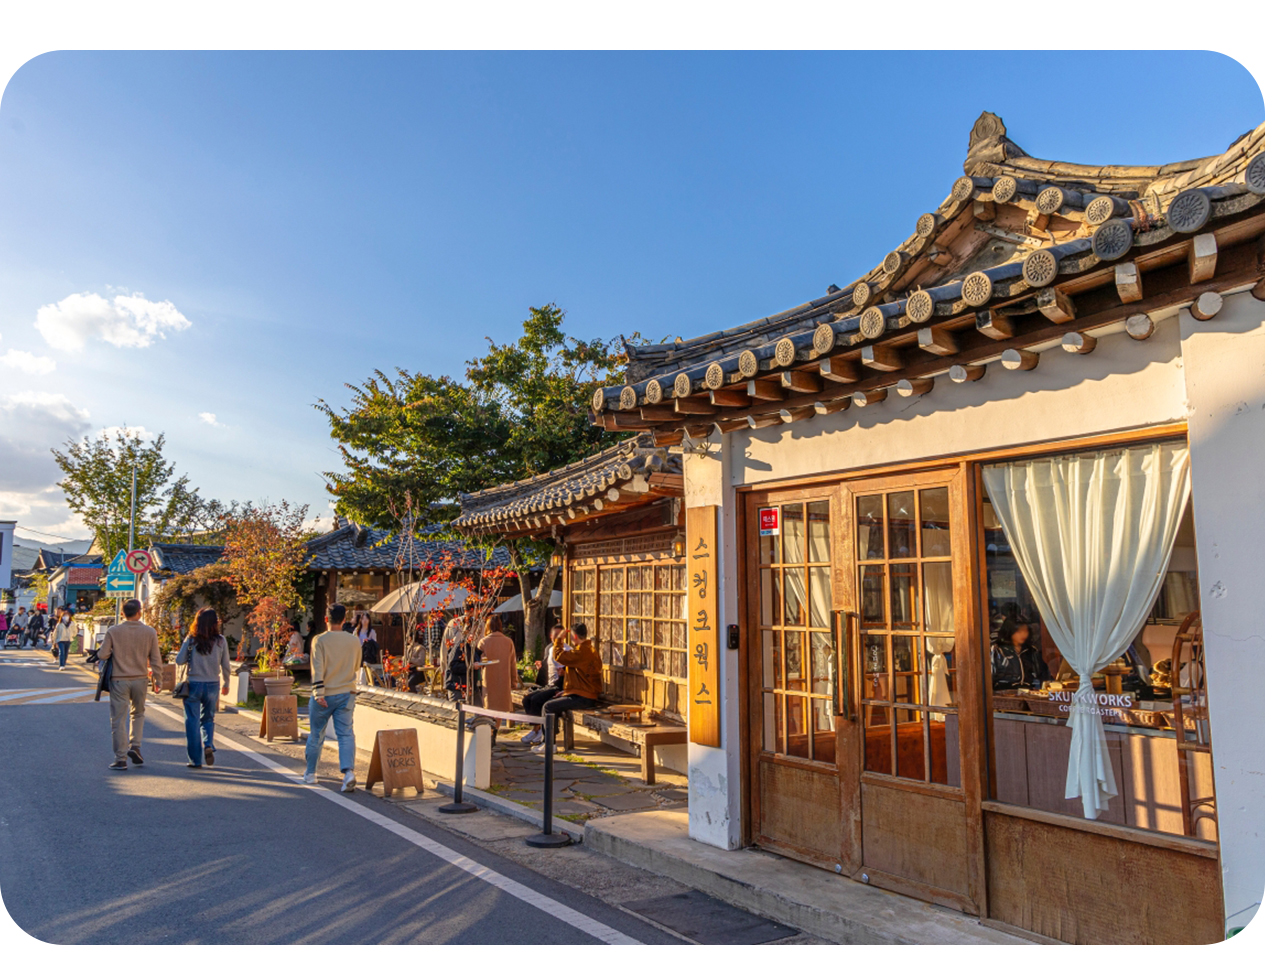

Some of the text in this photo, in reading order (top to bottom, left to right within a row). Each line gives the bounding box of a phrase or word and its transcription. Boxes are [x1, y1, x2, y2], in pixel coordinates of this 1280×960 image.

[271, 707, 293, 715] SKUNK
[271, 715, 294, 723] WORKS
[386, 746, 414, 757] SKUNK
[387, 757, 415, 768] WORKS
